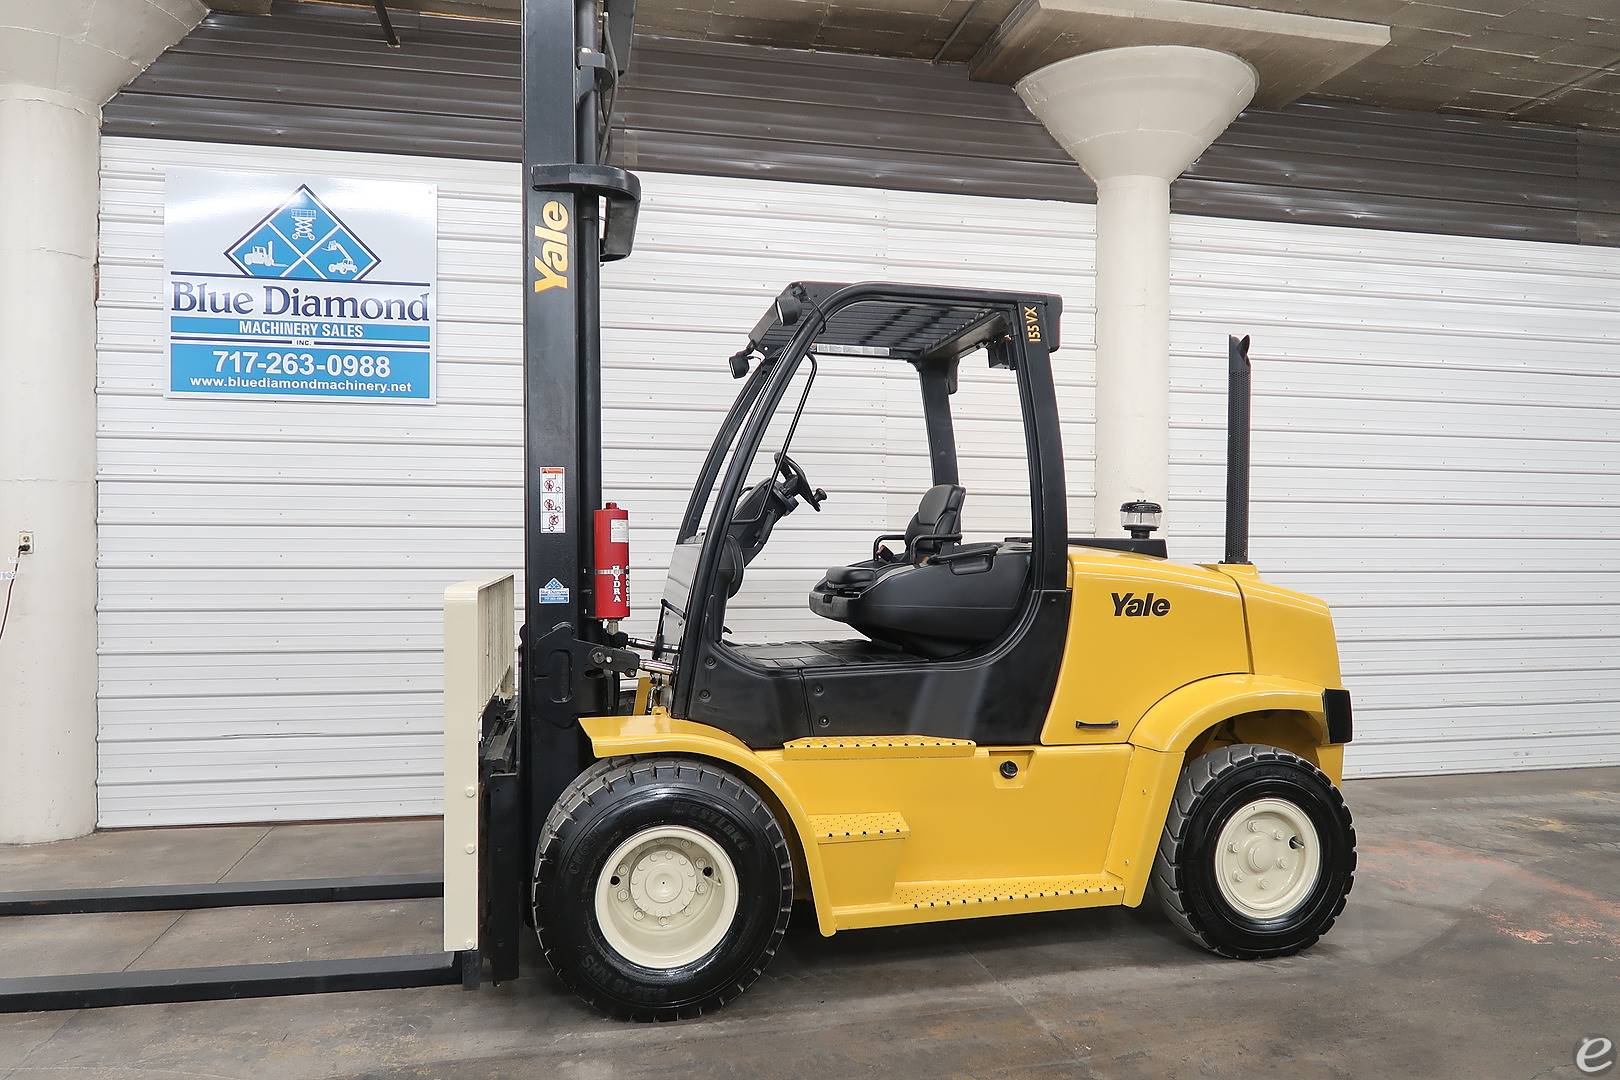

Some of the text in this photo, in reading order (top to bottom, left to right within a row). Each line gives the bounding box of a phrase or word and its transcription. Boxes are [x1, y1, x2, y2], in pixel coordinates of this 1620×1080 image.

[534, 201, 569, 293] Yale
[171, 281, 429, 321] Blue Diamond
[239, 321, 363, 337] MACHINERY SALES
[212, 350, 391, 377] 717-263-0988
[190, 377, 412, 393] www.bluediamondmachinery.net
[1111, 592, 1171, 617] Yale
